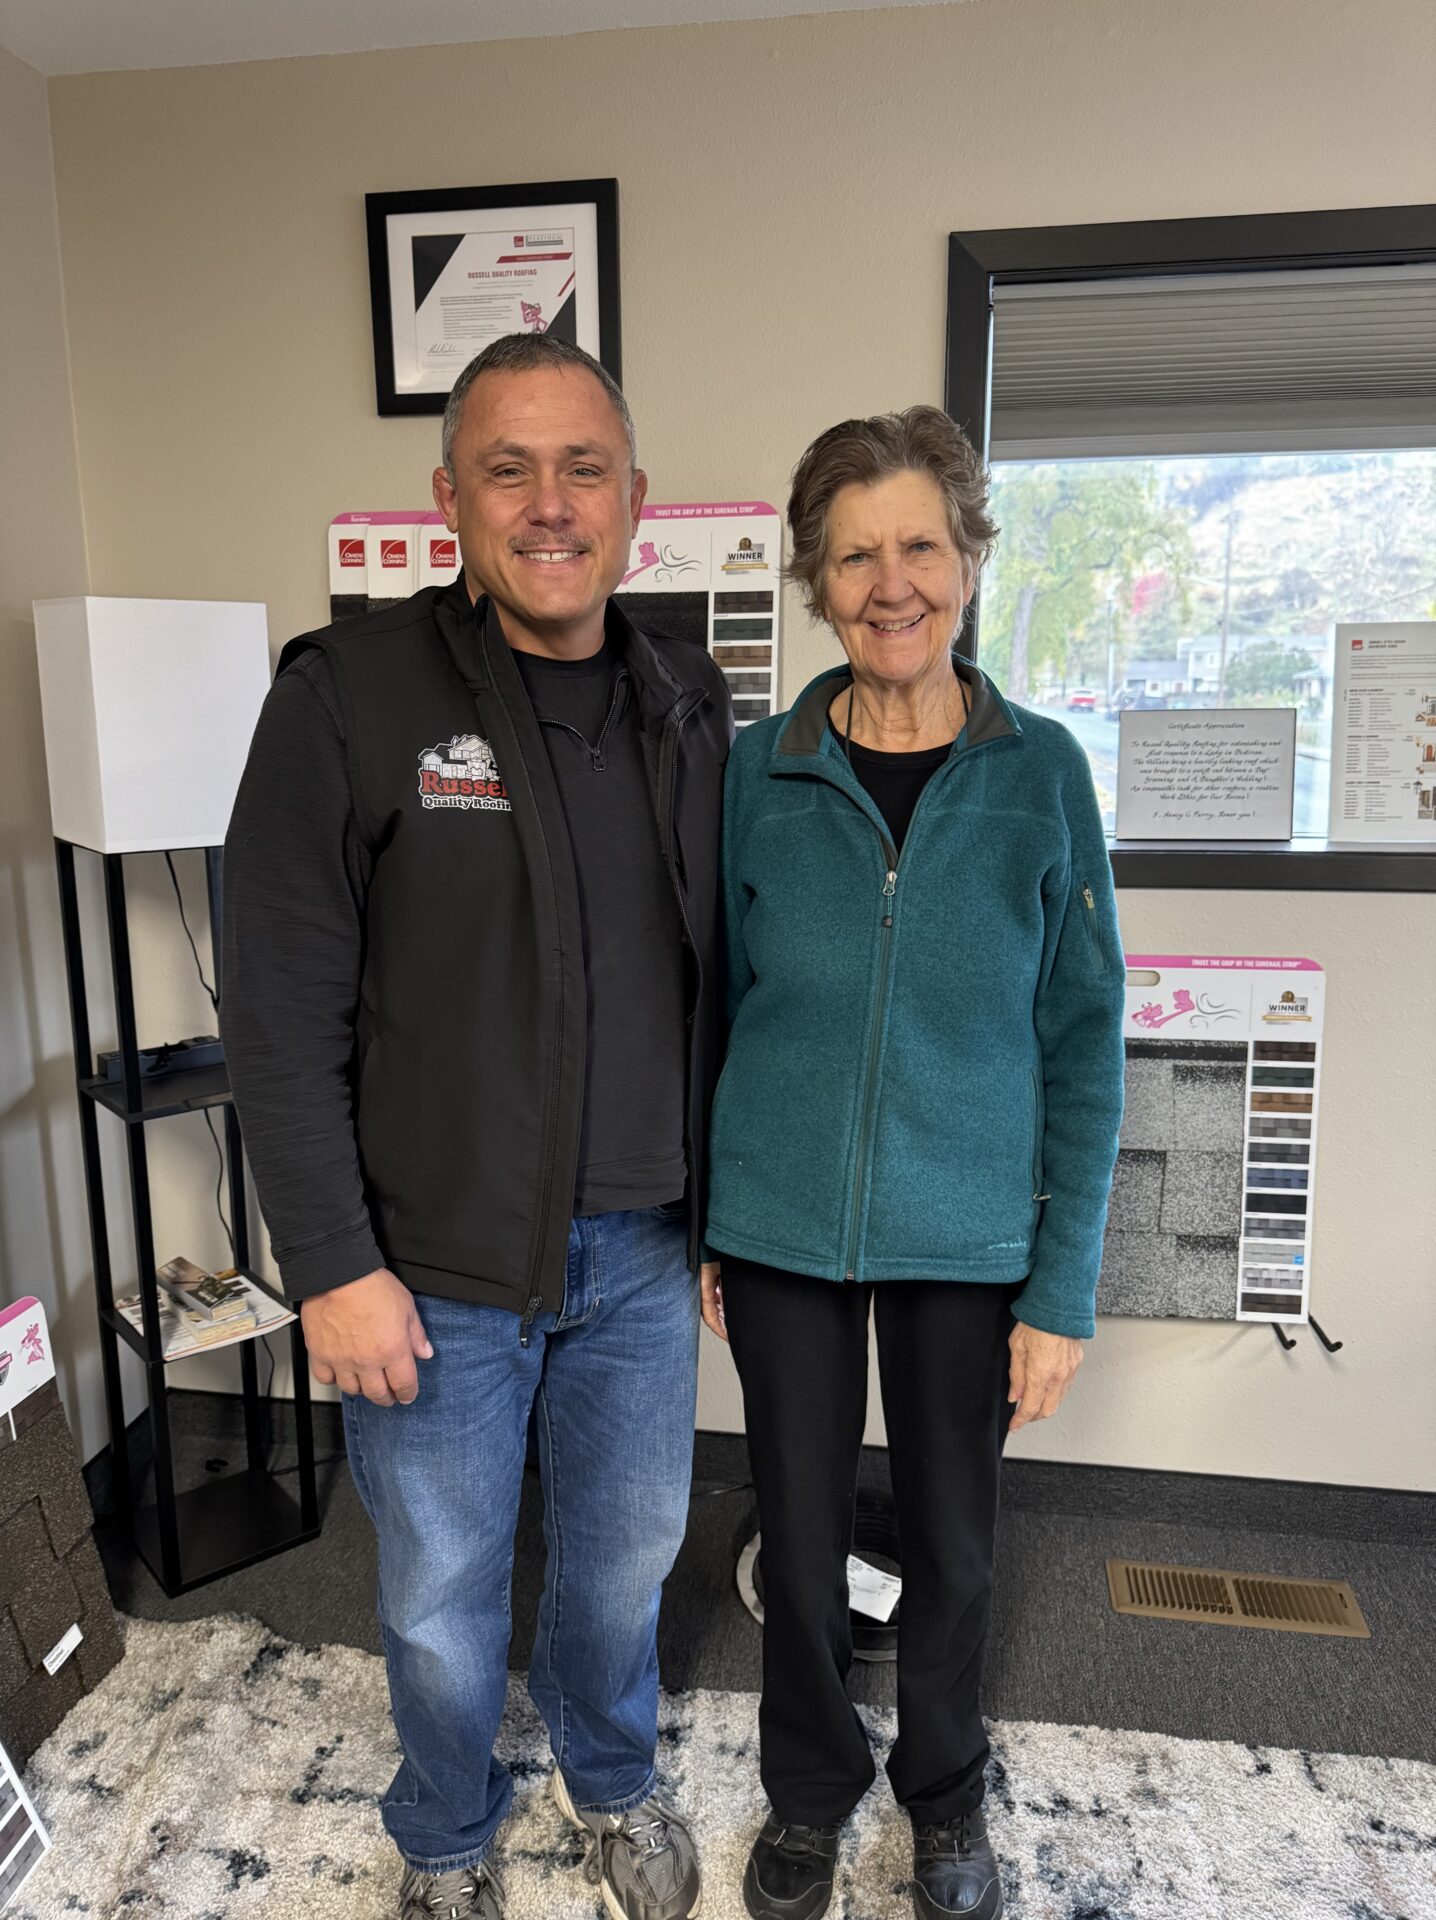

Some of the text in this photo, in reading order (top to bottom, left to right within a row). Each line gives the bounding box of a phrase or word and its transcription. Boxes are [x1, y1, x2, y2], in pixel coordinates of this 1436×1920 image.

[468, 268, 537, 279] RUSSELL QUALITY ROOFING
[672, 508, 681, 516] THE
[682, 508, 694, 516] GRIP
[703, 507, 713, 515] THE
[727, 552, 764, 561] WINNER
[1202, 722, 1245, 730] Appreciation
[423, 796, 470, 808] Quality
[1221, 959, 1234, 967] GRIP
[1269, 1004, 1306, 1012] WINNER
